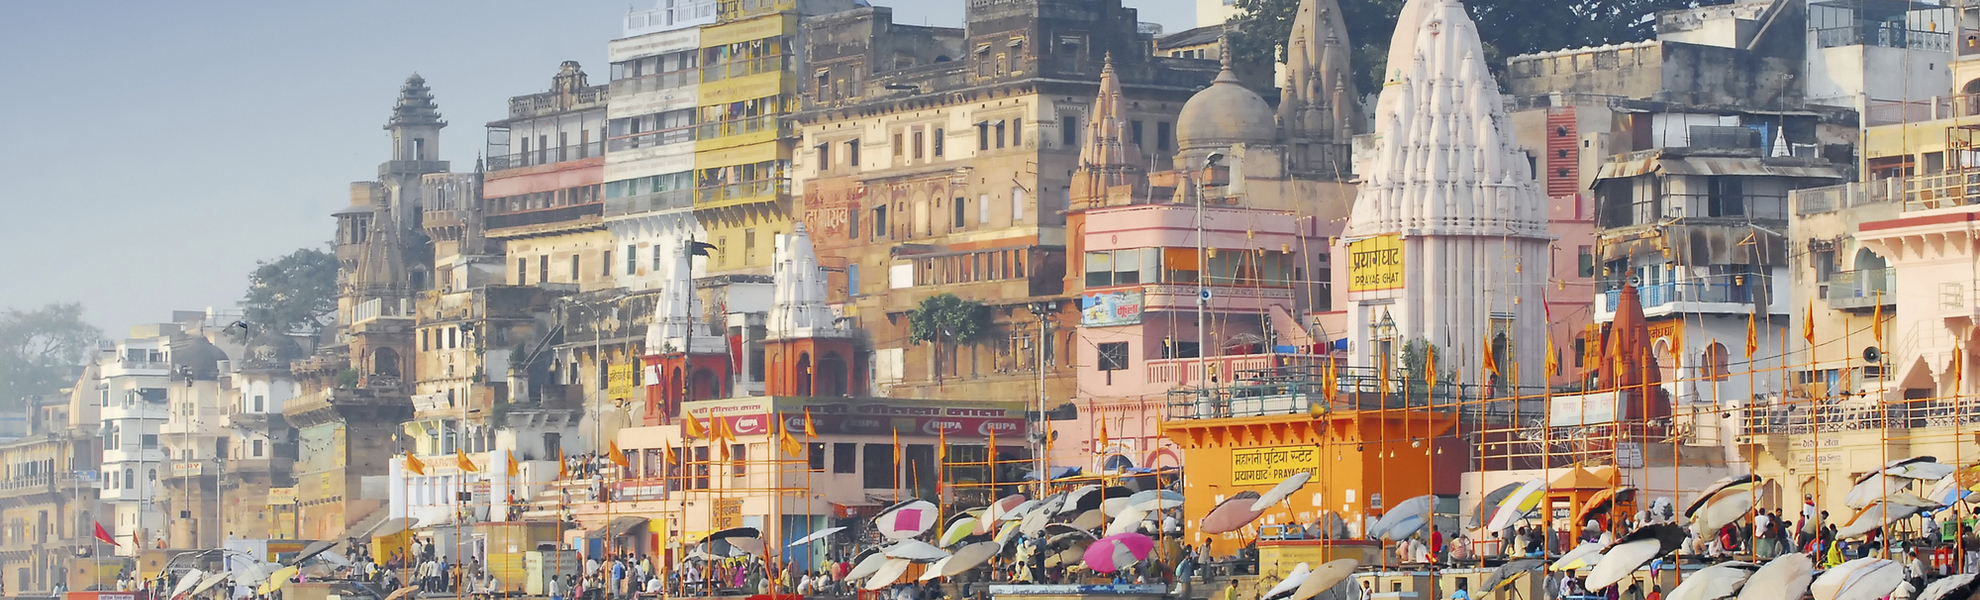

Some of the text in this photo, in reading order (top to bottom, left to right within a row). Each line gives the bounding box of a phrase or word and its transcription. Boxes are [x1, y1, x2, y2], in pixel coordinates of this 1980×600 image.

[1354, 271, 1399, 286] PRAYAG GHAT
[932, 421, 962, 430] RUPA
[987, 422, 1017, 431] RUPA
[1273, 467, 1300, 479] PRAYAG
